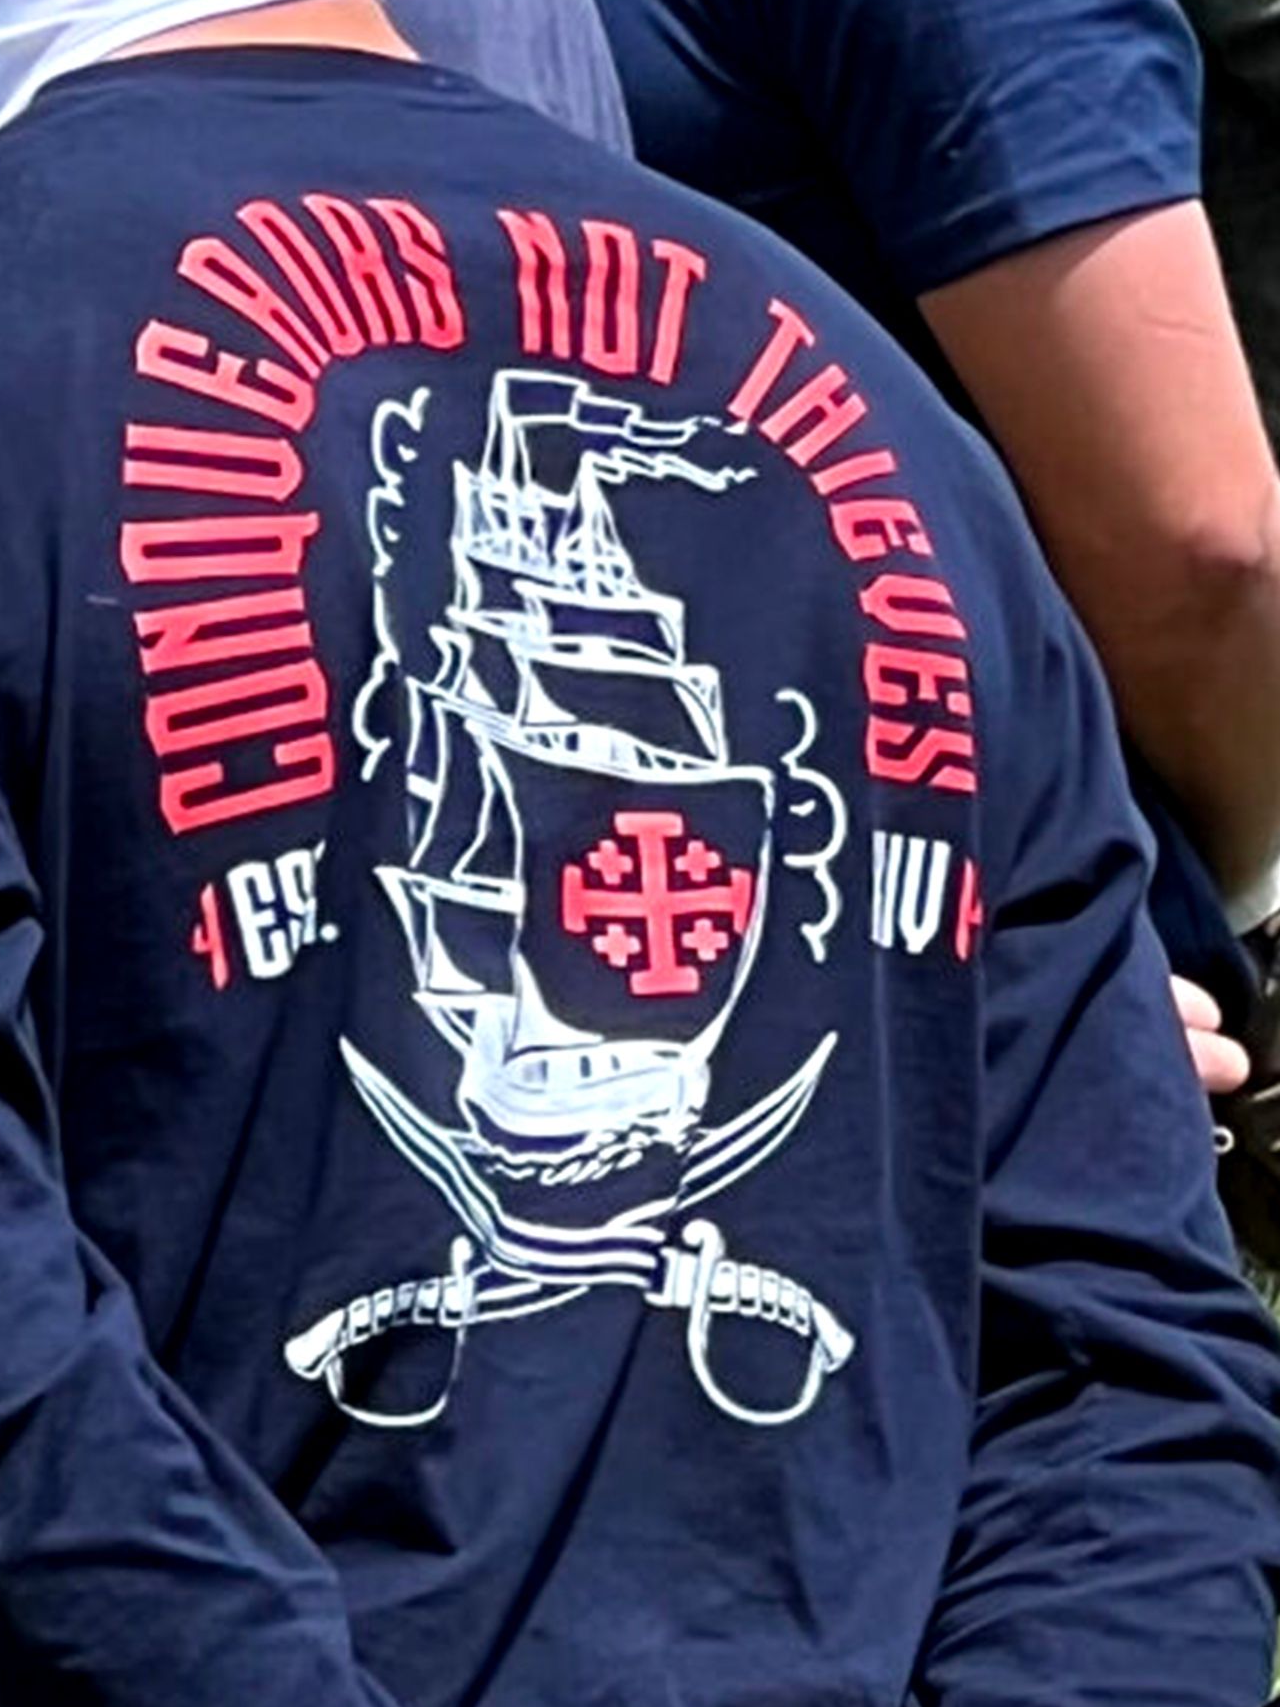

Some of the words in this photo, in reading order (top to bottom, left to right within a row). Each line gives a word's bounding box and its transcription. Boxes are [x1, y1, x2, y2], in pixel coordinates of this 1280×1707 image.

[120, 193, 465, 835] CONQUERORS
[496, 209, 706, 384] NOT
[725, 298, 978, 793] THIEVES
